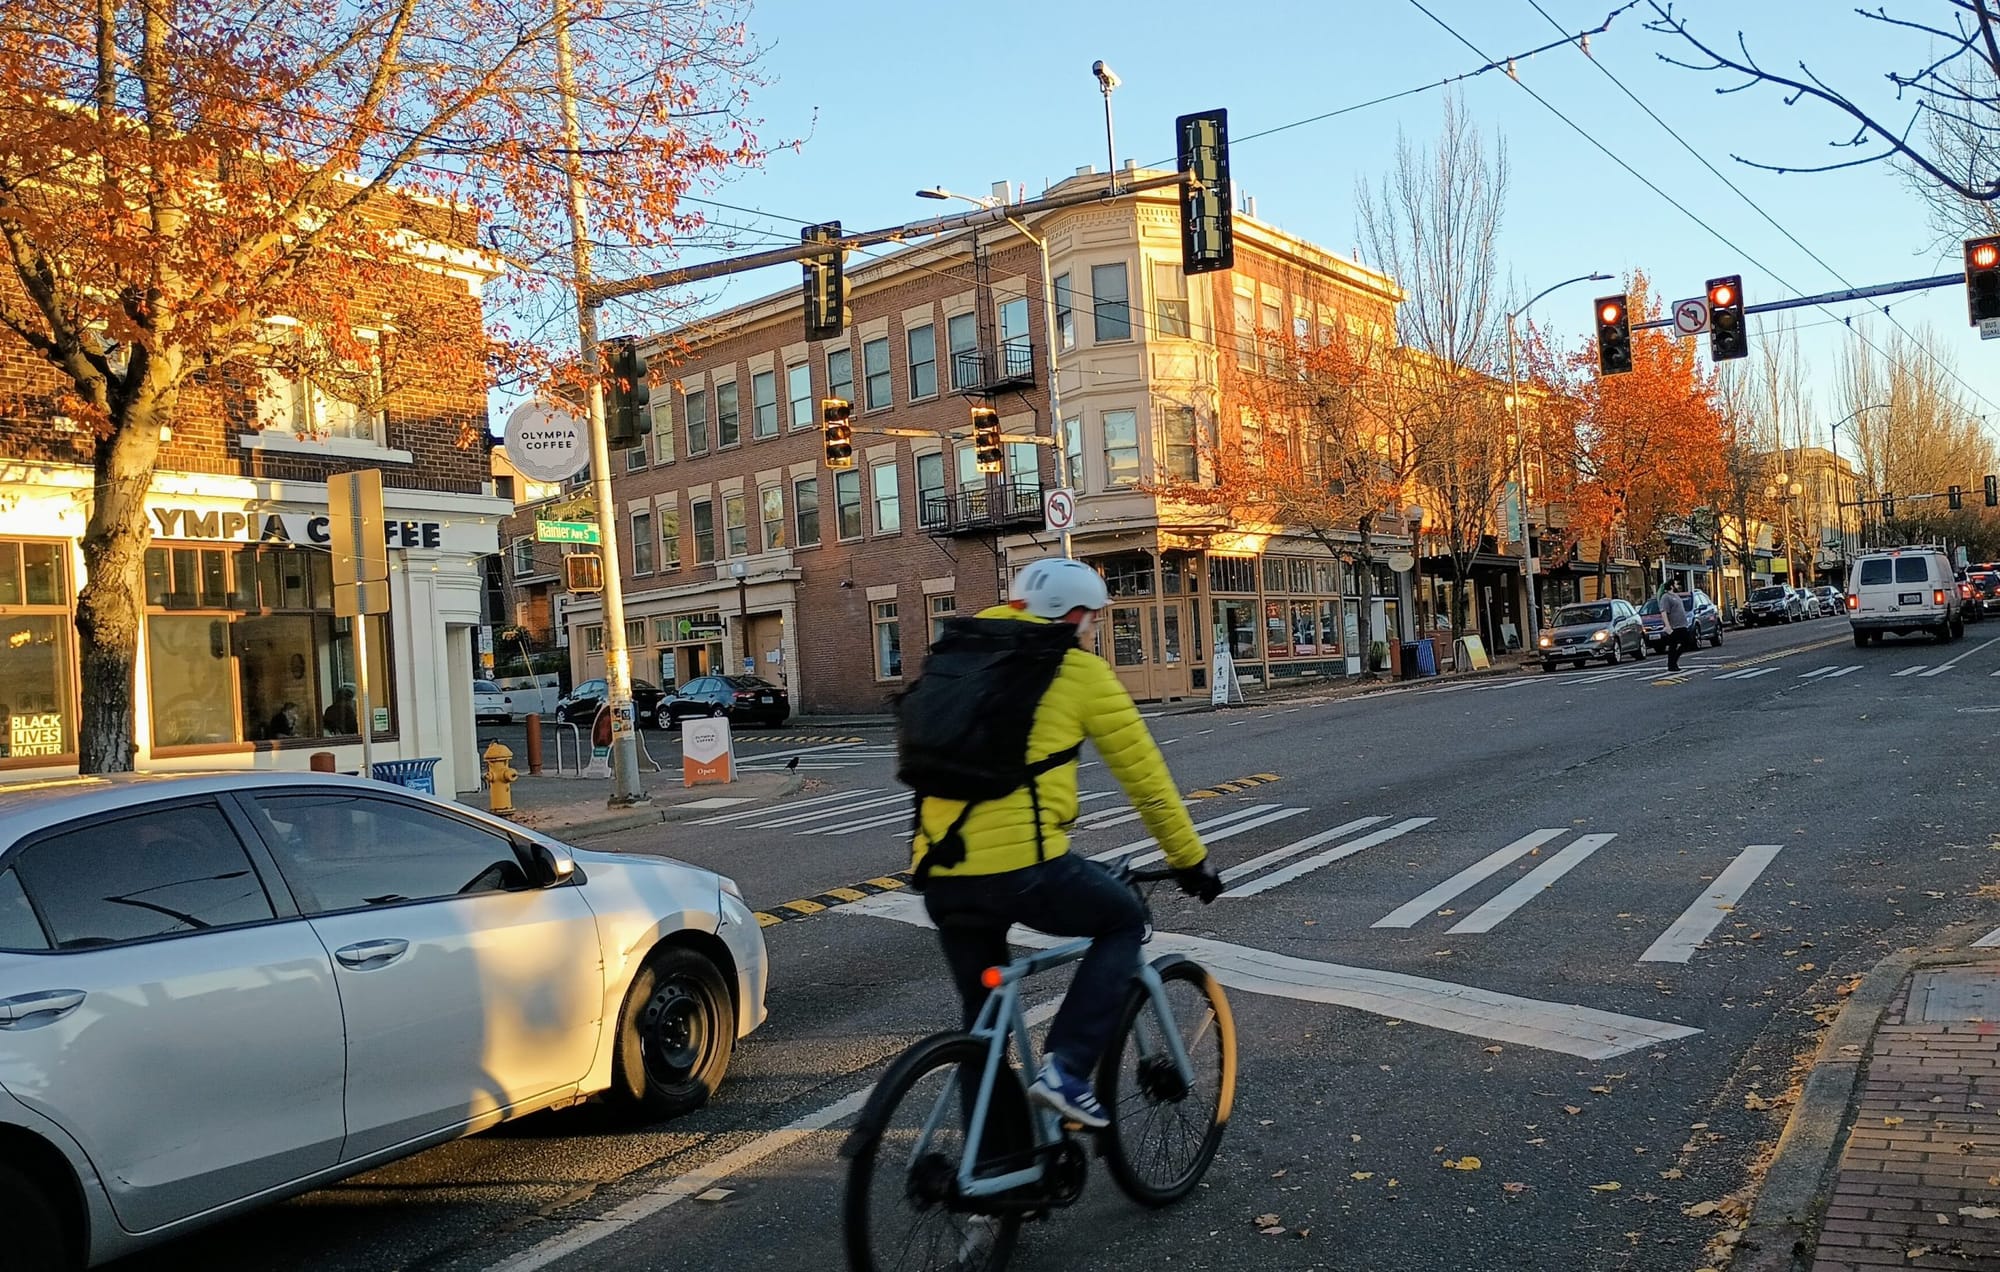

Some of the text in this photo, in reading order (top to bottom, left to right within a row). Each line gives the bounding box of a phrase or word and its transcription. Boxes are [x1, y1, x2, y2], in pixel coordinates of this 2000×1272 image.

[1984, 321, 1997, 329] BUS
[521, 431, 575, 440] OLYMPIA
[526, 441, 572, 450] COFFEE
[148, 508, 441, 548] YMPIA CFEE
[540, 522, 590, 540] Rainier Ave S
[12, 714, 61, 729] BLACK
[15, 729, 59, 744] LIVES
[12, 744, 61, 757] MATTER
[697, 768, 716, 776] Open
